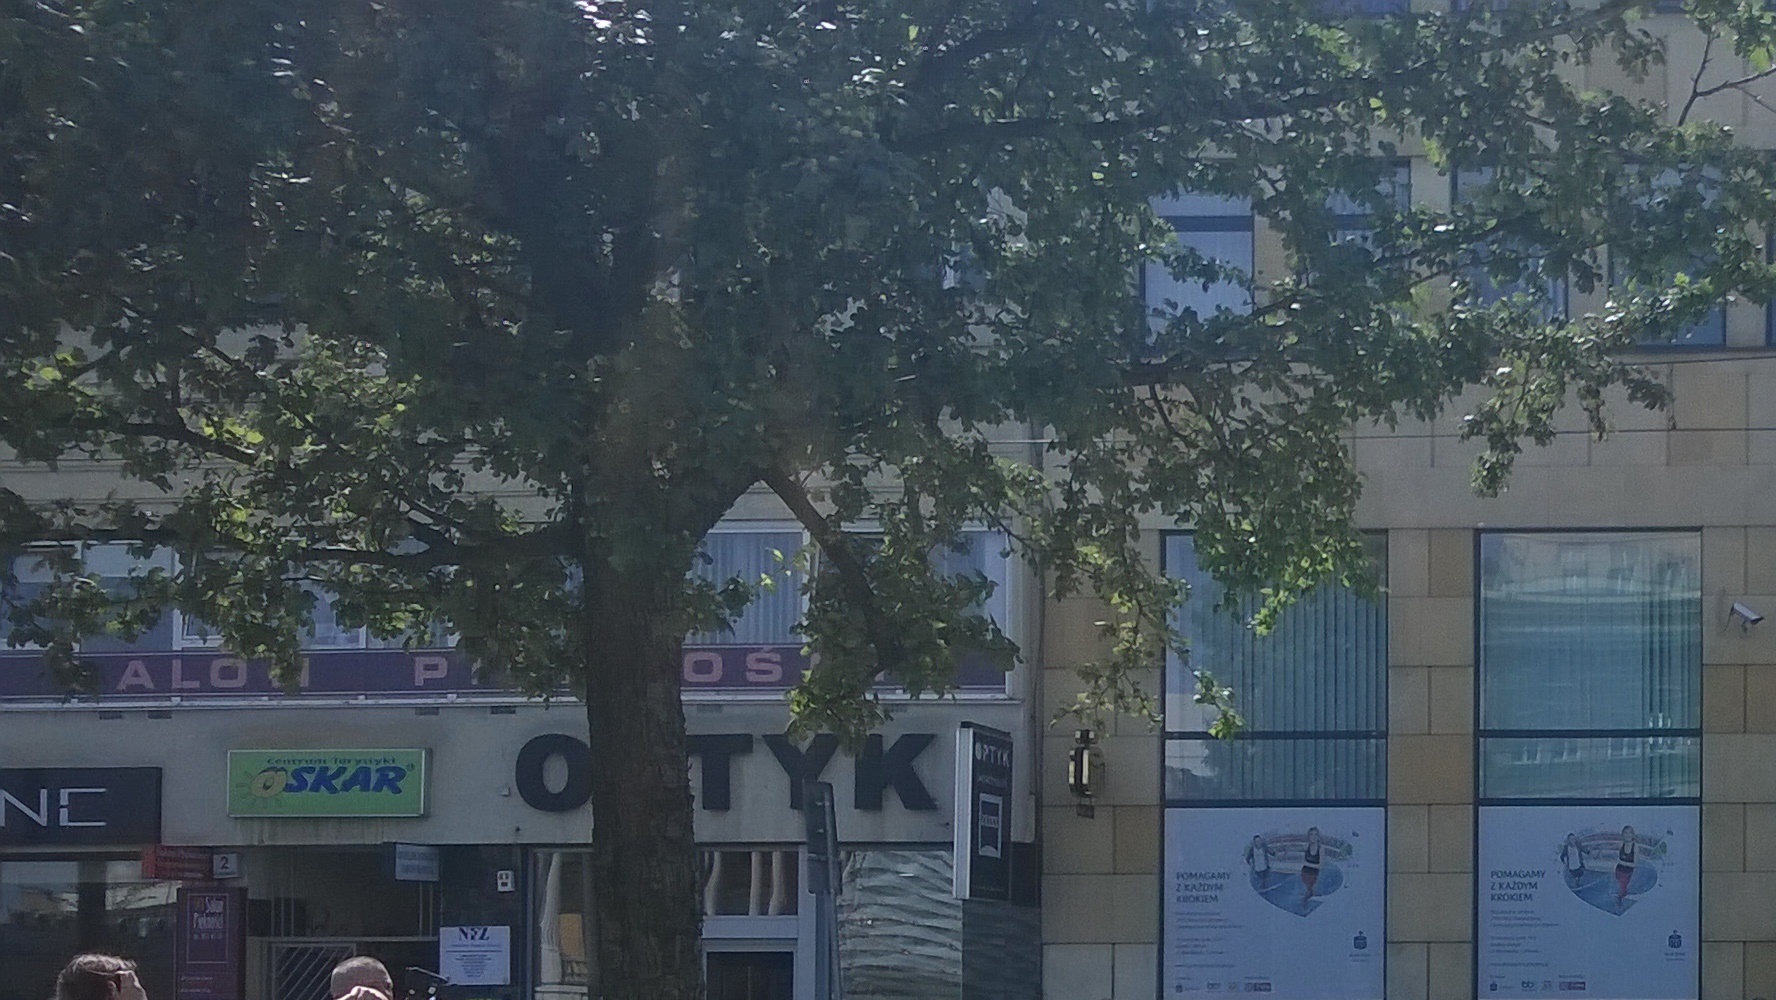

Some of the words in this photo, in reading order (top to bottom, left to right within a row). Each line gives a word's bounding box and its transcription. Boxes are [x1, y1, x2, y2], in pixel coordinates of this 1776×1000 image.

[267, 757, 326, 766] Centrum
[516, 733, 938, 813] OTYK
[250, 765, 407, 799] OSKAR
[220, 855, 230, 870] 2
[1176, 871, 1231, 880] POMAGAMY
[1490, 870, 1547, 879] POMAGAMY
[1176, 895, 1219, 903] KROKIEM
[1490, 893, 1533, 902] KROKIEM
[458, 926, 491, 942] NFZ
